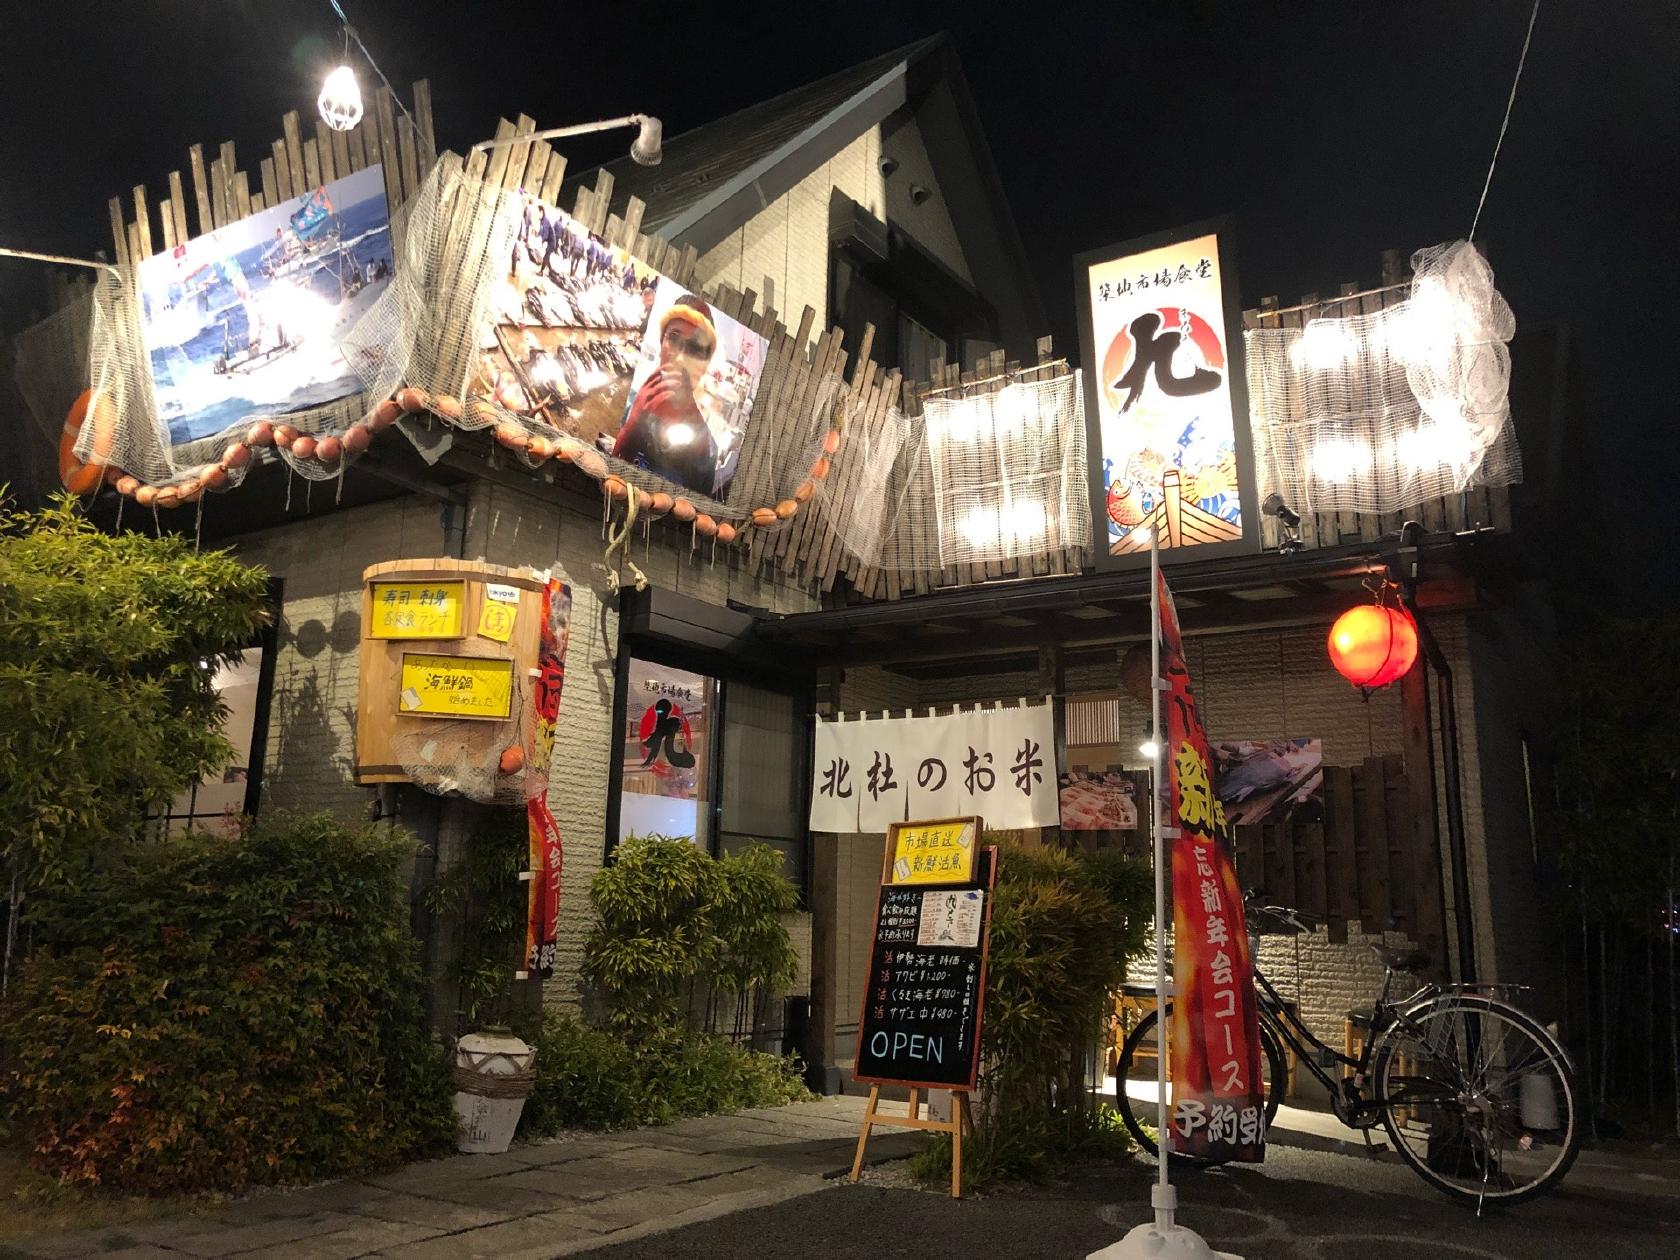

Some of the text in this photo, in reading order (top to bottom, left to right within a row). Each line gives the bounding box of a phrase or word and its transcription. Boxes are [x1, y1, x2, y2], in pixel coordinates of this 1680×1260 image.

[423, 672, 474, 691] 海鮮鍋
[819, 738, 1044, 802] 北杜のお米
[904, 830, 955, 852] 市場直送
[871, 1031, 943, 1064] OPEN
